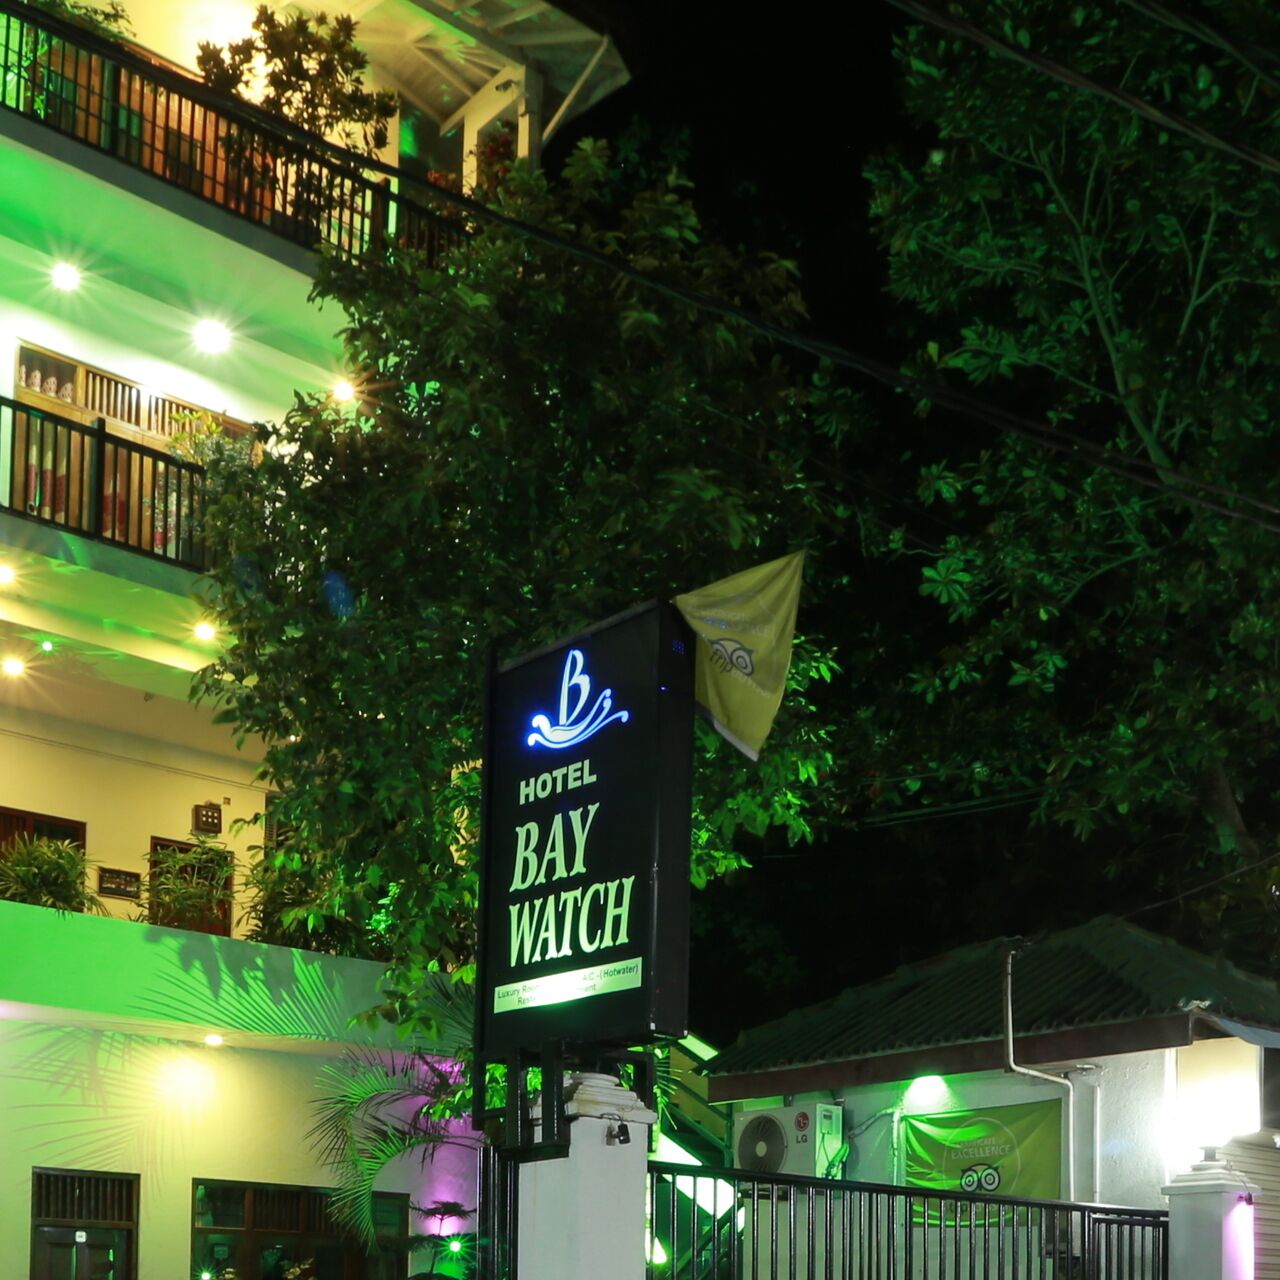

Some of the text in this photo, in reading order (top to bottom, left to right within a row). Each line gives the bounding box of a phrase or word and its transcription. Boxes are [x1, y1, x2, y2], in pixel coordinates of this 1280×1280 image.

[519, 758, 597, 806] HOTEL
[508, 802, 600, 893] BAY
[508, 875, 636, 968] WATCH
[497, 988, 520, 999] Luxury
[795, 1134, 808, 1144] LG
